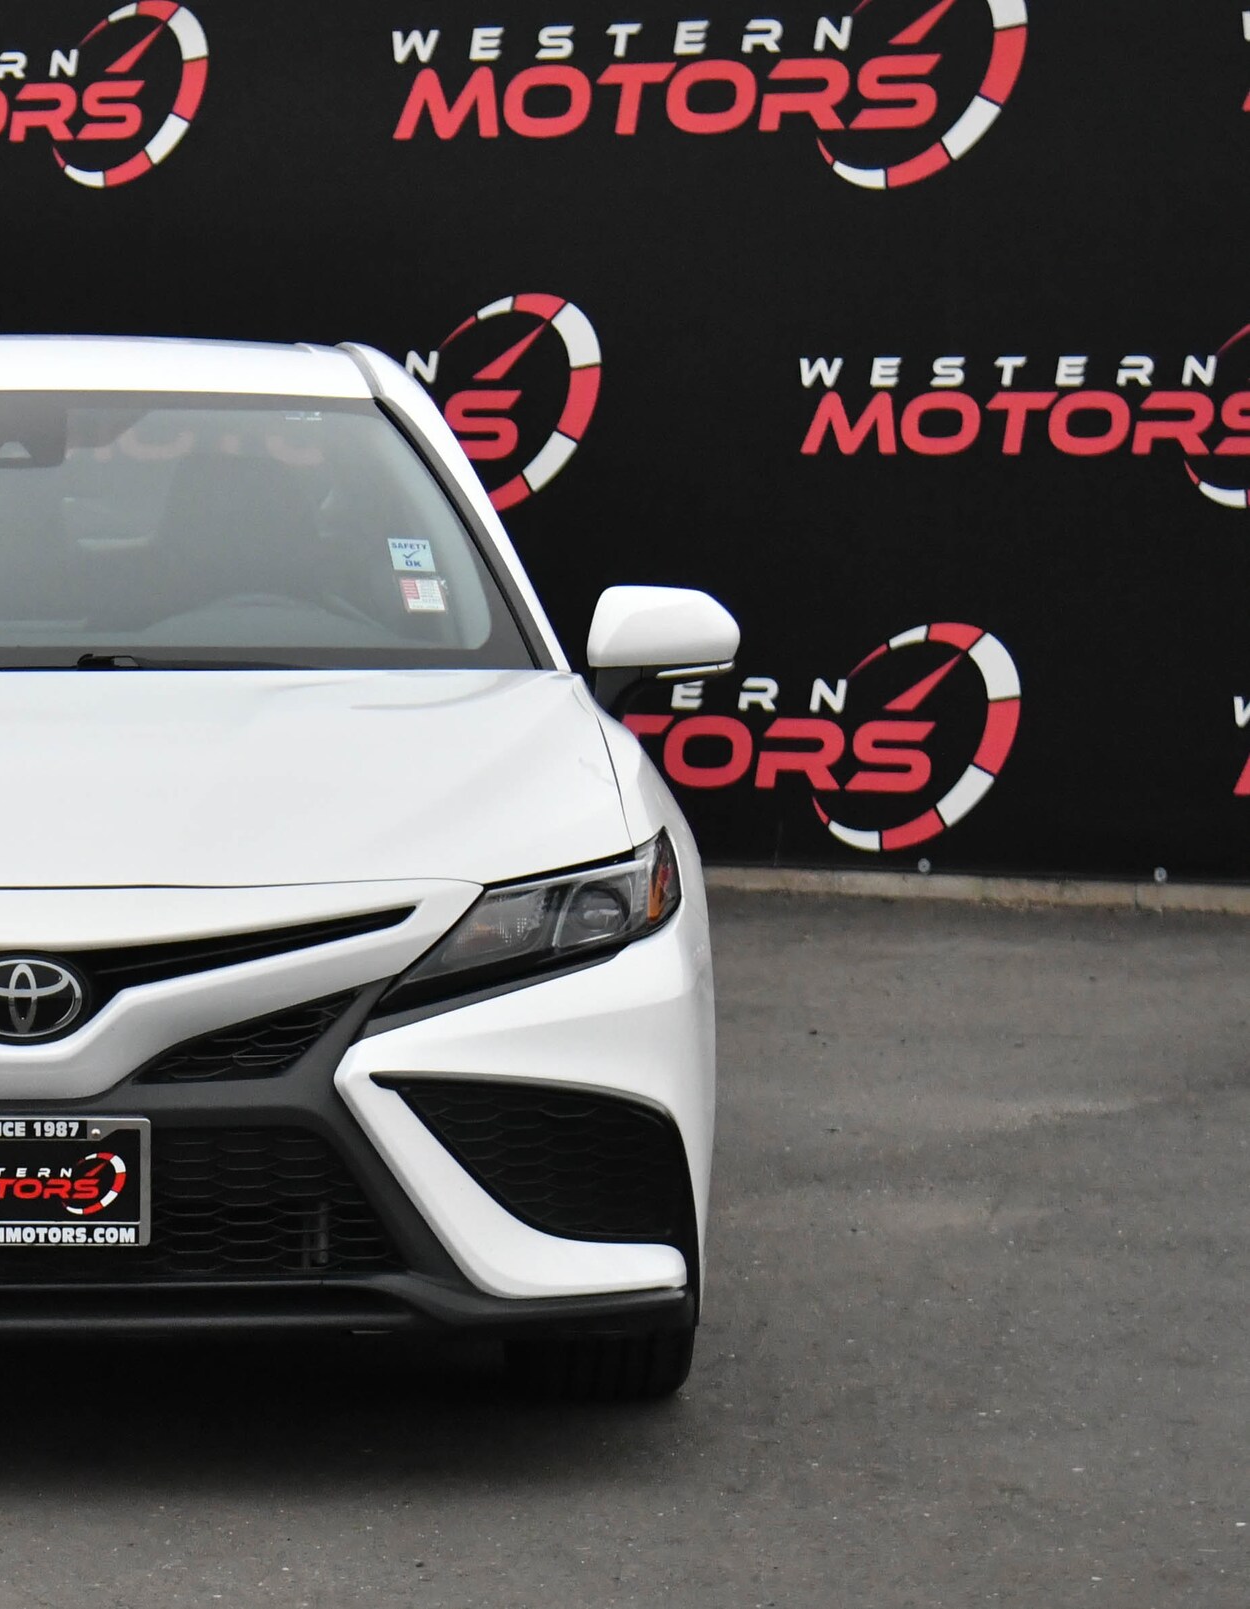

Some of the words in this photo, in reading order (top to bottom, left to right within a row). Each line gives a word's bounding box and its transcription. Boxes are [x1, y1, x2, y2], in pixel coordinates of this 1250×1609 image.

[392, 15, 853, 64] WESTERN
[393, 53, 942, 141] MOTORS
[799, 355, 1218, 388] WESTERN
[391, 542, 427, 550] SAFETY
[405, 559, 422, 567] OK
[33, 1121, 80, 1137] 1987
